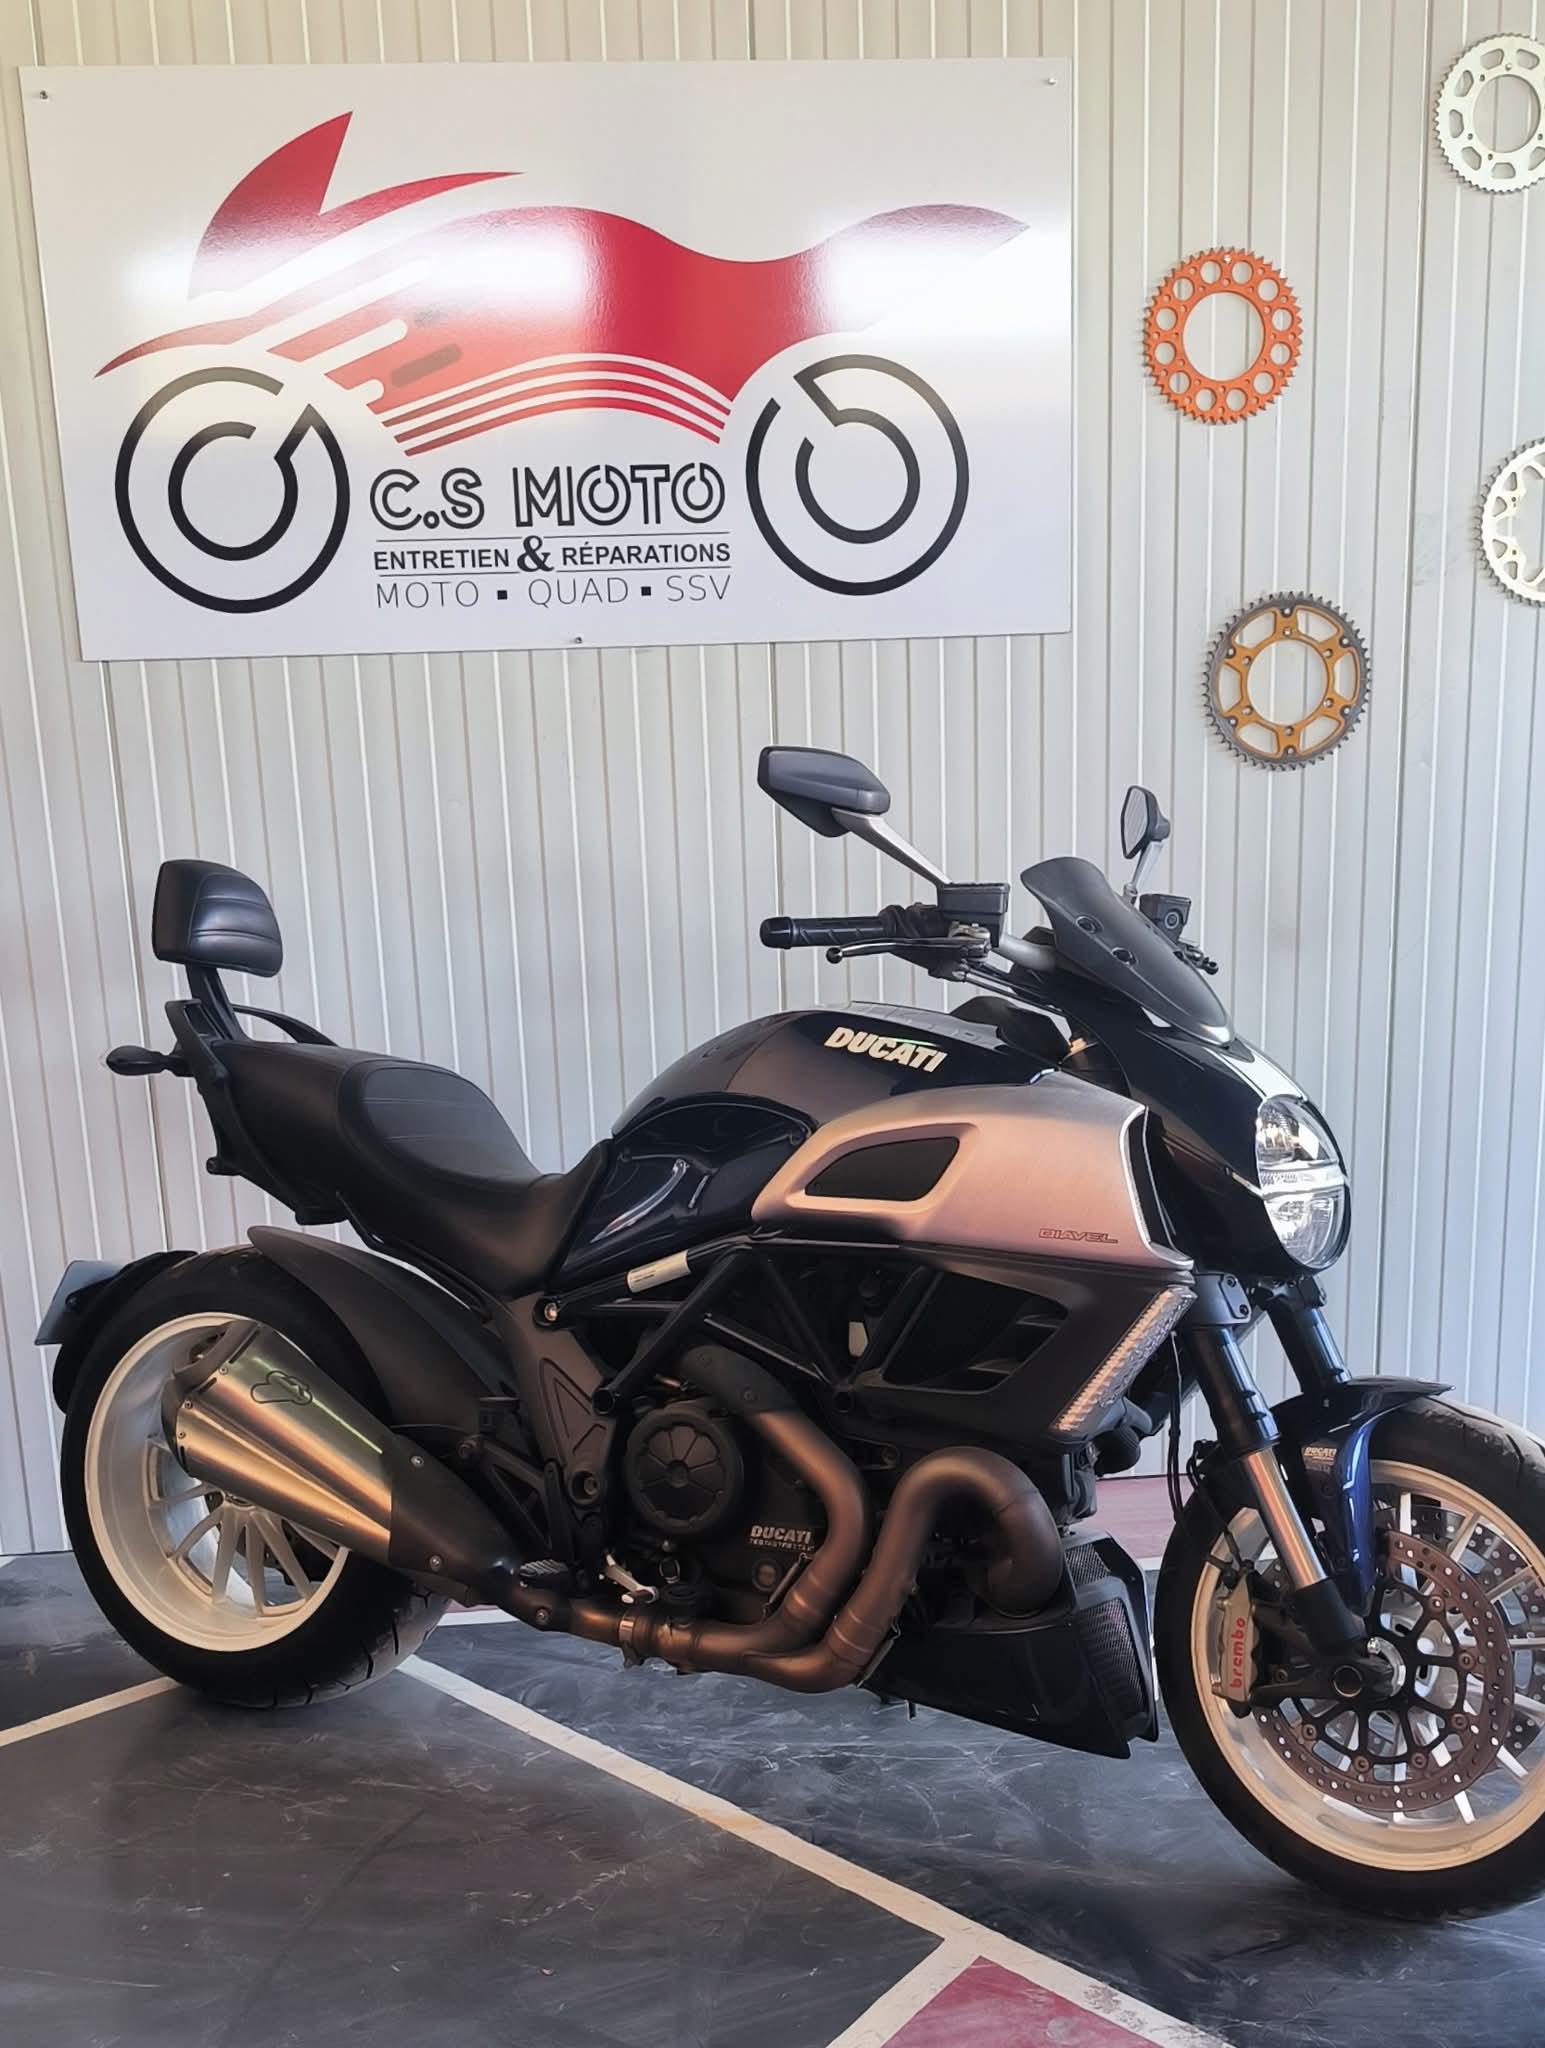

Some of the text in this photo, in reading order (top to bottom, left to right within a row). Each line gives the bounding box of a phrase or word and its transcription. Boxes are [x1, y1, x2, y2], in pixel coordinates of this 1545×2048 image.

[512, 462, 726, 528] MOTO
[373, 535, 731, 573] ENTRETIEN & RÉPARATIONS
[376, 574, 731, 609] MOTO QUAD SSV
[824, 1026, 948, 1073] DUCATI
[750, 1525, 812, 1544] DUCATI
[1230, 1617, 1246, 1688] brembo
